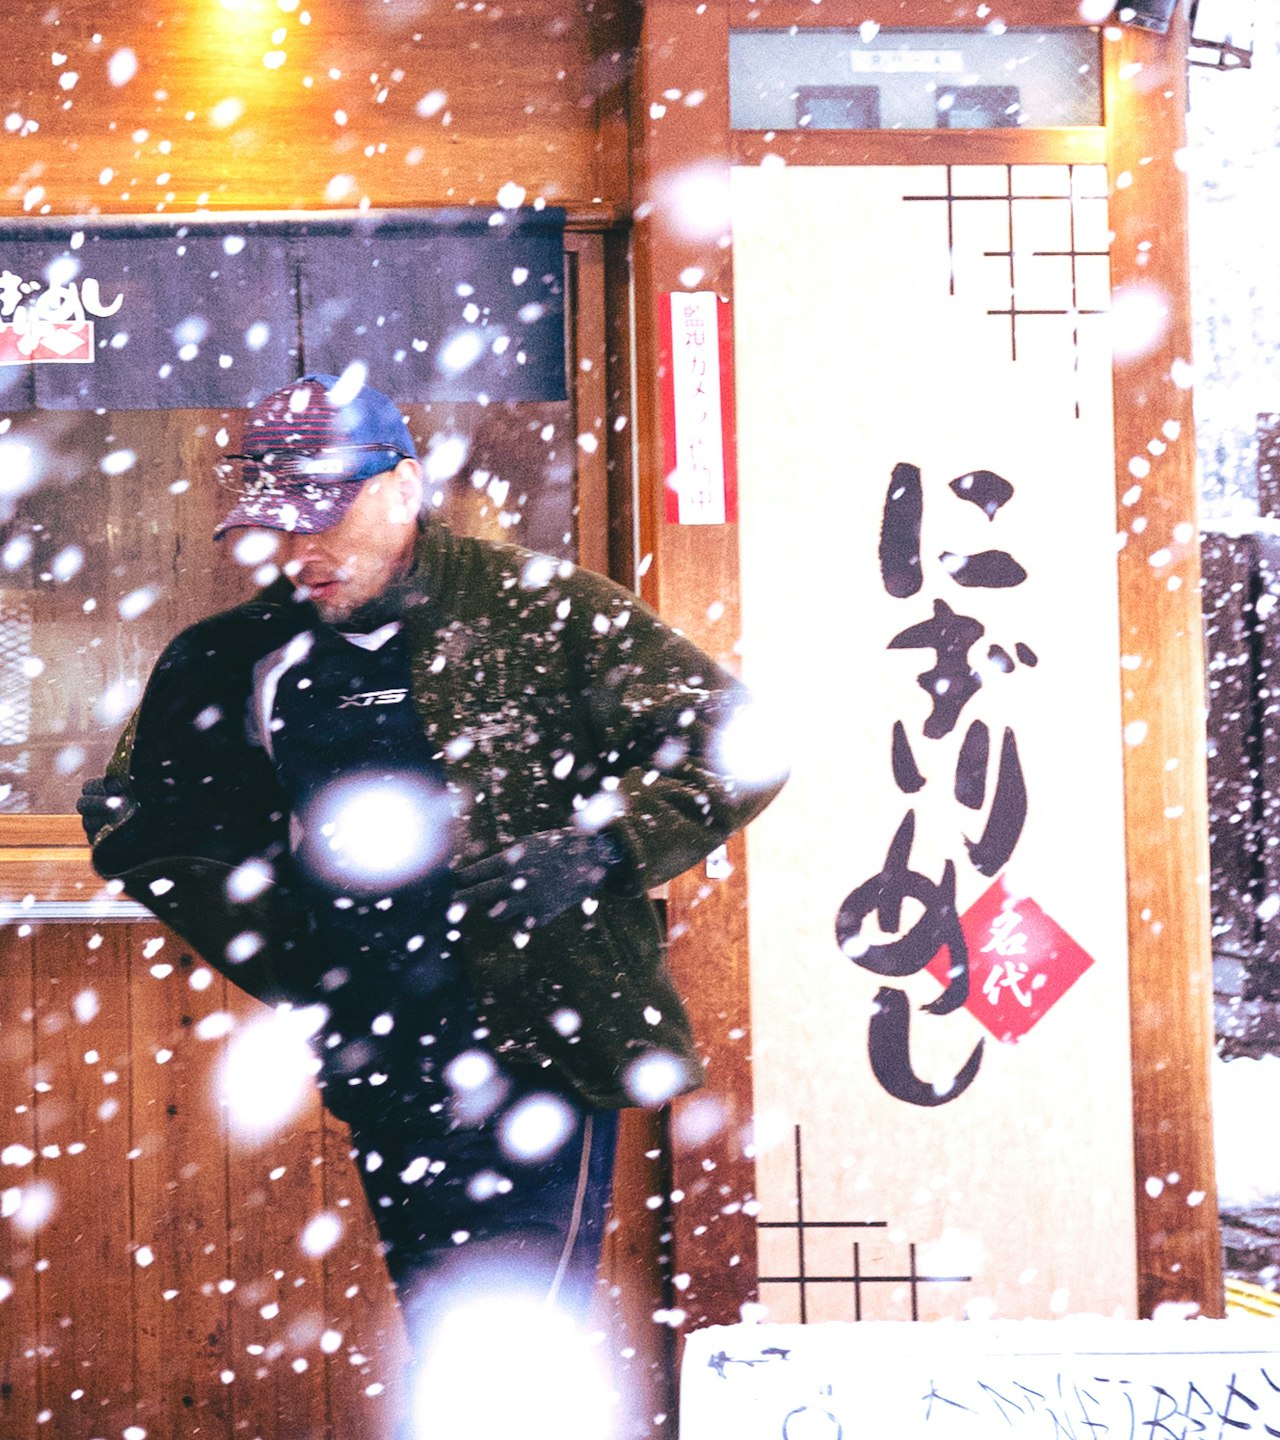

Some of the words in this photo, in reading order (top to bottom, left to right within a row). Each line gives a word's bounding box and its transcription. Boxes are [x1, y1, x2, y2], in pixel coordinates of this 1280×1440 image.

[682, 304, 713, 511] 監視カメ中
[834, 461, 1038, 1107] にぎりめし
